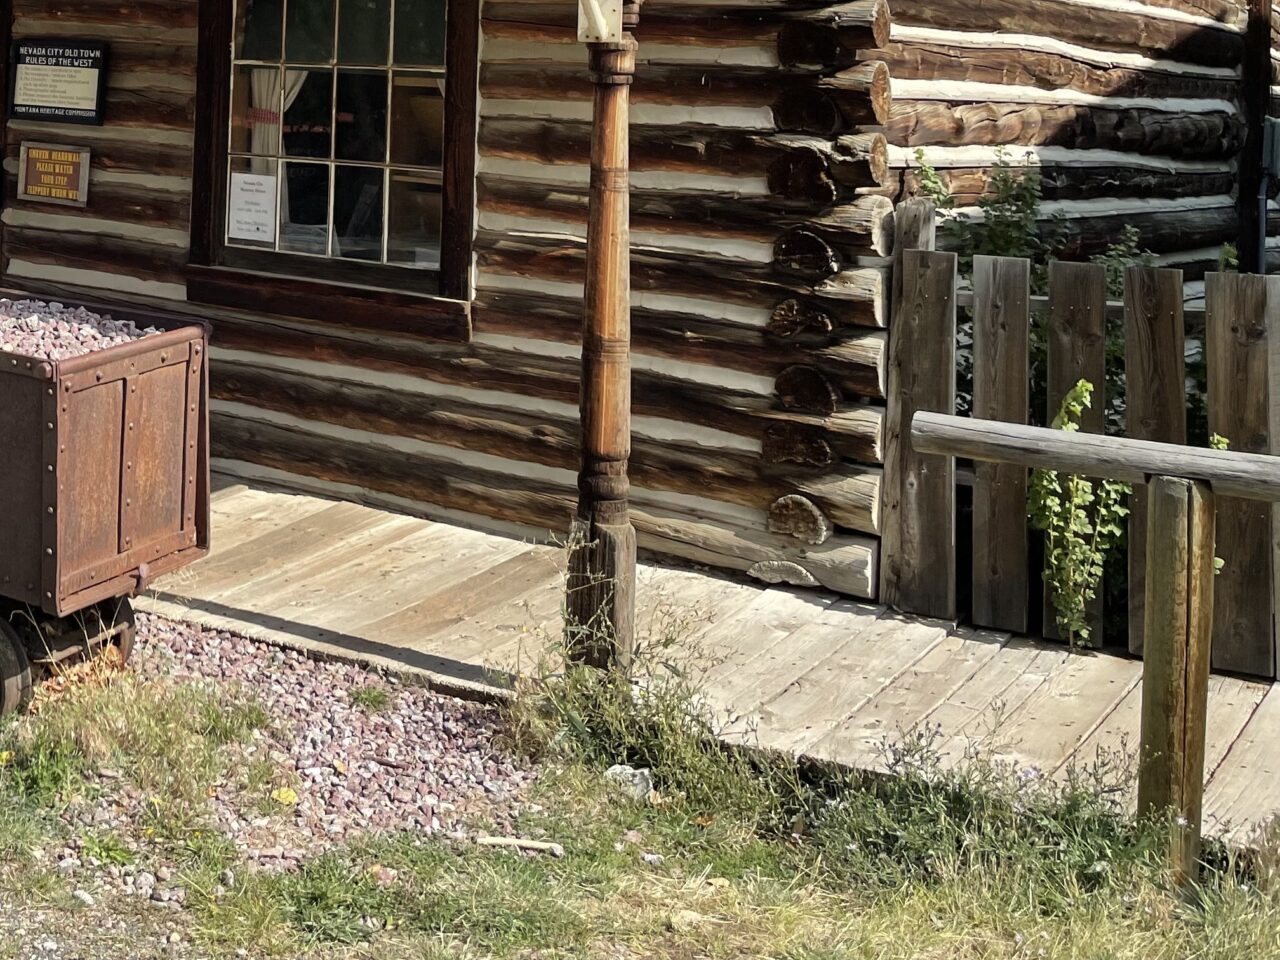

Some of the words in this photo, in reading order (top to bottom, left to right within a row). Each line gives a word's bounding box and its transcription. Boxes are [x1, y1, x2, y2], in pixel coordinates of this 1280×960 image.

[19, 46, 46, 56] NEVADA
[47, 47, 63, 57] CITY
[64, 48, 78, 57] OLD
[80, 49, 101, 58] TOWN
[25, 56, 46, 65] RULES
[48, 57, 57, 65] OF
[58, 58, 72, 66] THE
[73, 59, 93, 67] WEST
